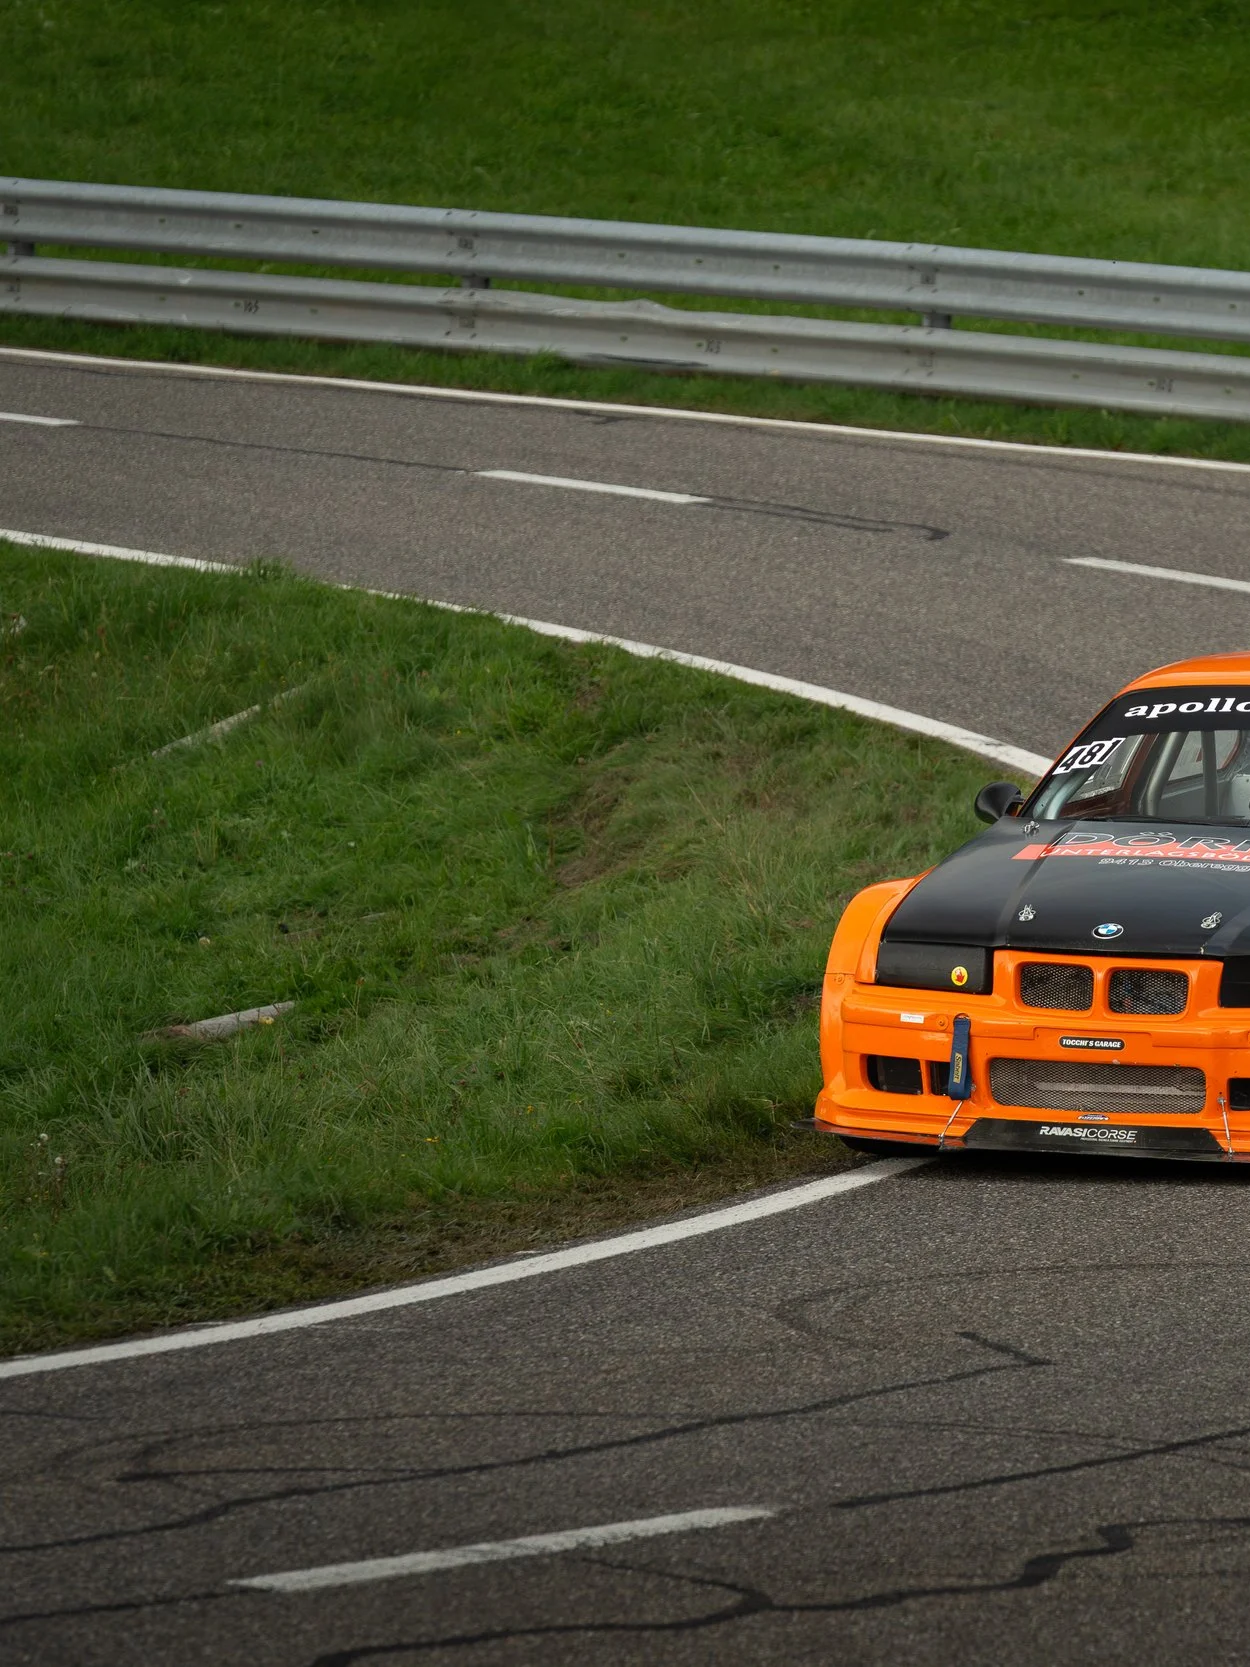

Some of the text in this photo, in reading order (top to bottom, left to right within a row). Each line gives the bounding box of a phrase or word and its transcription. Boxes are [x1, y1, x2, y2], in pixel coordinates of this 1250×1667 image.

[1058, 740, 1123, 772] 481
[1098, 858, 1154, 867] 9413
[1094, 1040, 1122, 1048] GARAGE
[1039, 1126, 1138, 1140] RAVASICORSE
